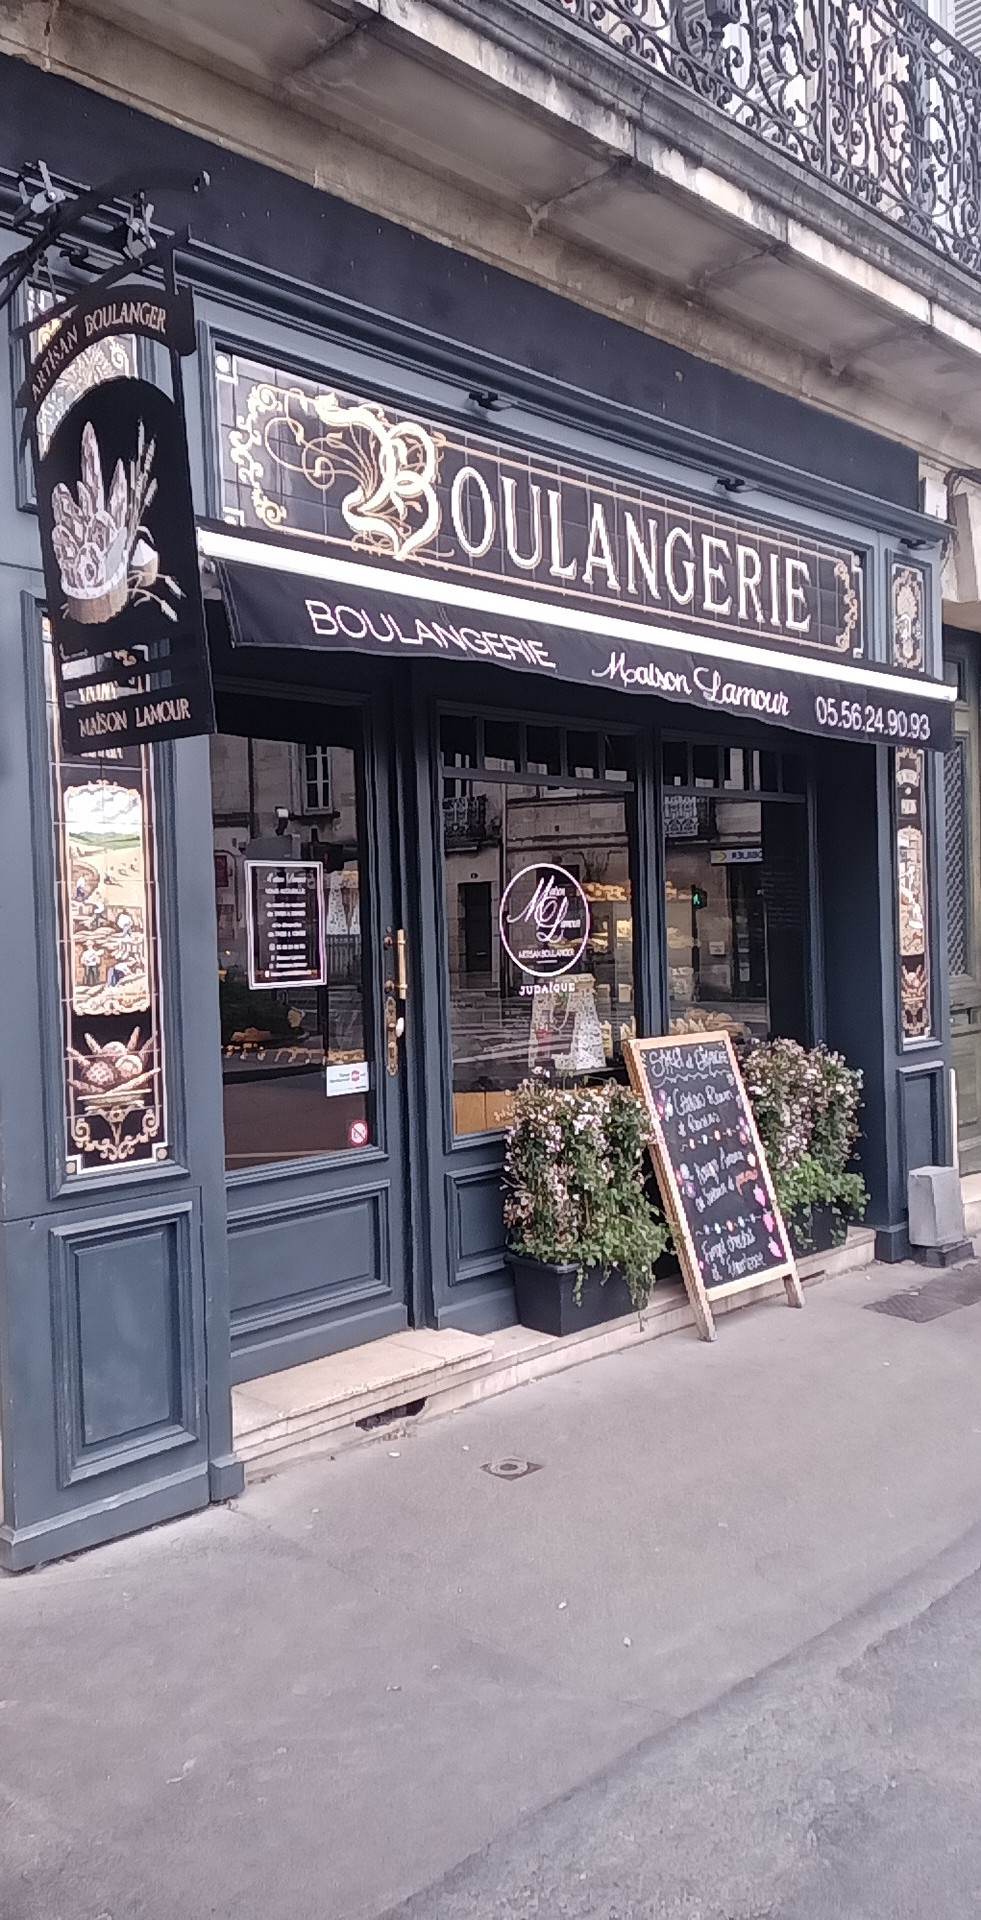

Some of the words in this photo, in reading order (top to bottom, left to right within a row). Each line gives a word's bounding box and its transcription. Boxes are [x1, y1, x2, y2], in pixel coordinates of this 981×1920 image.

[32, 324, 78, 401] ARTISAN
[84, 302, 166, 336] BOULANGER
[316, 391, 812, 632] BOULANGERIE
[79, 704, 127, 737] MAISON
[136, 697, 191, 727] LAMOUR
[305, 600, 556, 668] BOULANGERIE
[592, 651, 692, 695] Maison
[693, 667, 790, 717] Lamour
[816, 696, 931, 740] 05.56.24.90.93
